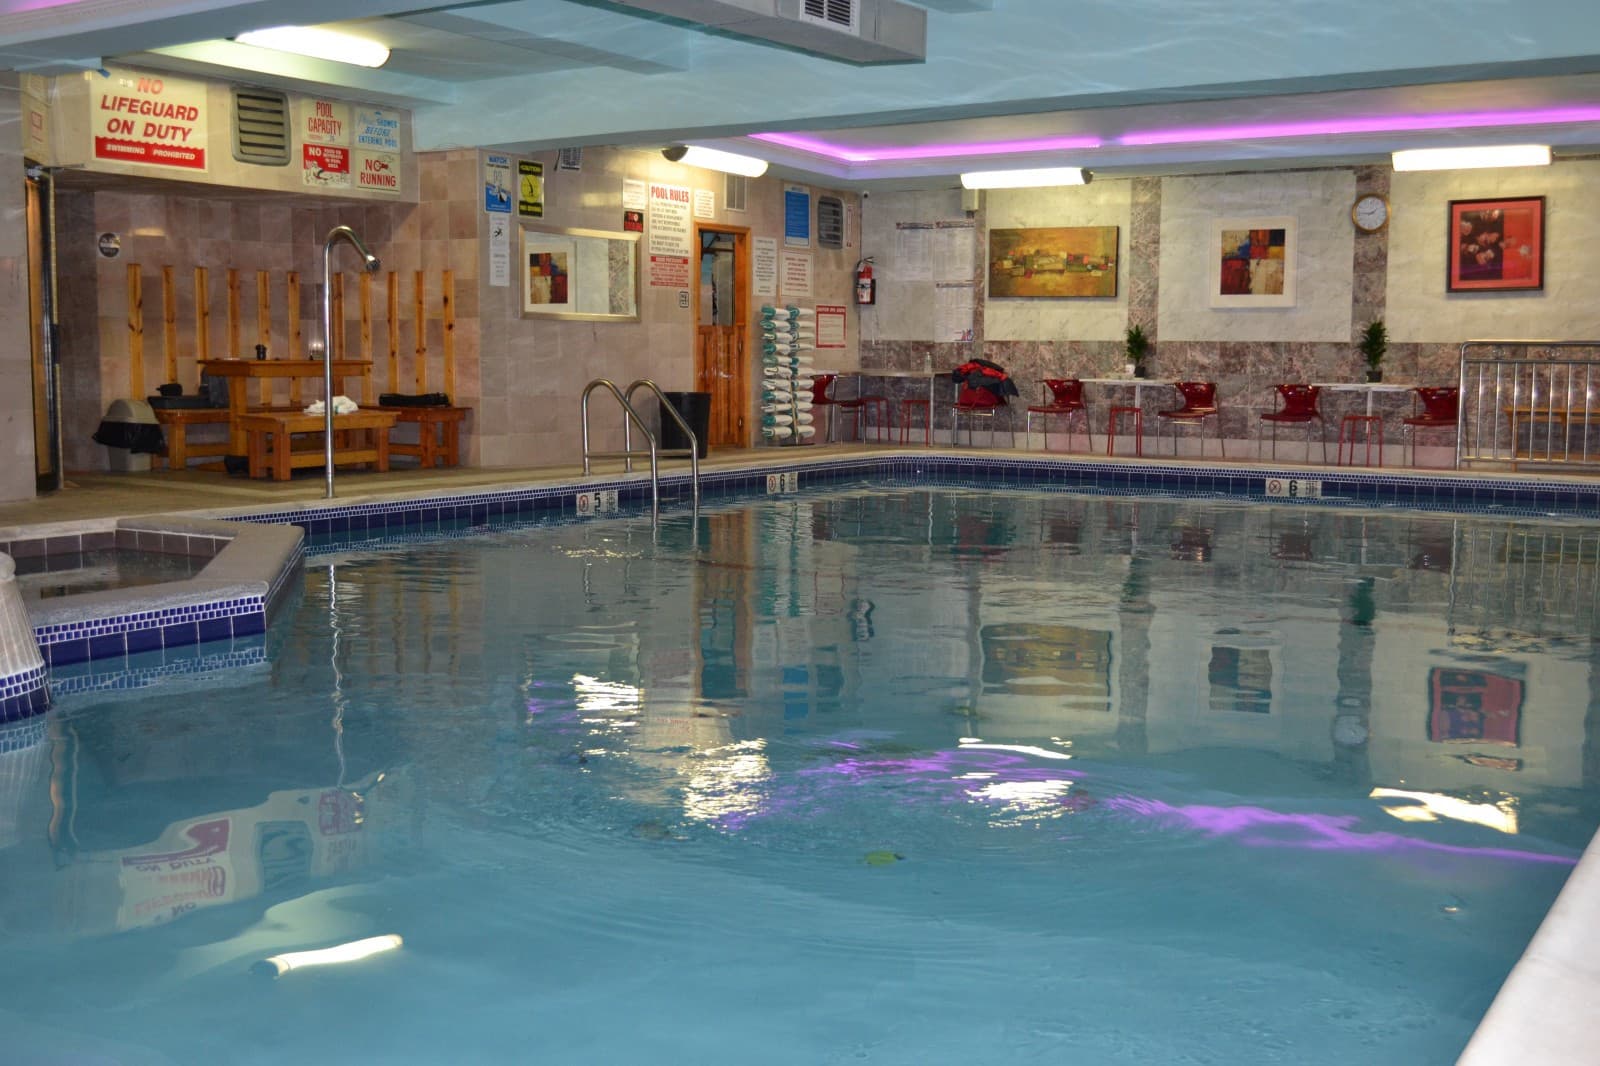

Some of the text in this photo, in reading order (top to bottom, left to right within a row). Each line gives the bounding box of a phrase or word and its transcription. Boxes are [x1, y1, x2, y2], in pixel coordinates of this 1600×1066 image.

[138, 77, 164, 94] NO
[101, 94, 199, 121] LIFEGUARD
[316, 101, 334, 118] POOL
[107, 118, 192, 142] ON DUTY
[308, 117, 342, 136] CAPACITY
[105, 143, 196, 160] SWIMMING PROHIBITED
[308, 146, 322, 156] NO
[365, 159, 382, 172] NO
[360, 172, 396, 187] RUNNING
[651, 186, 669, 200] POOL
[669, 188, 689, 203] RULES
[594, 492, 601, 512] 5
